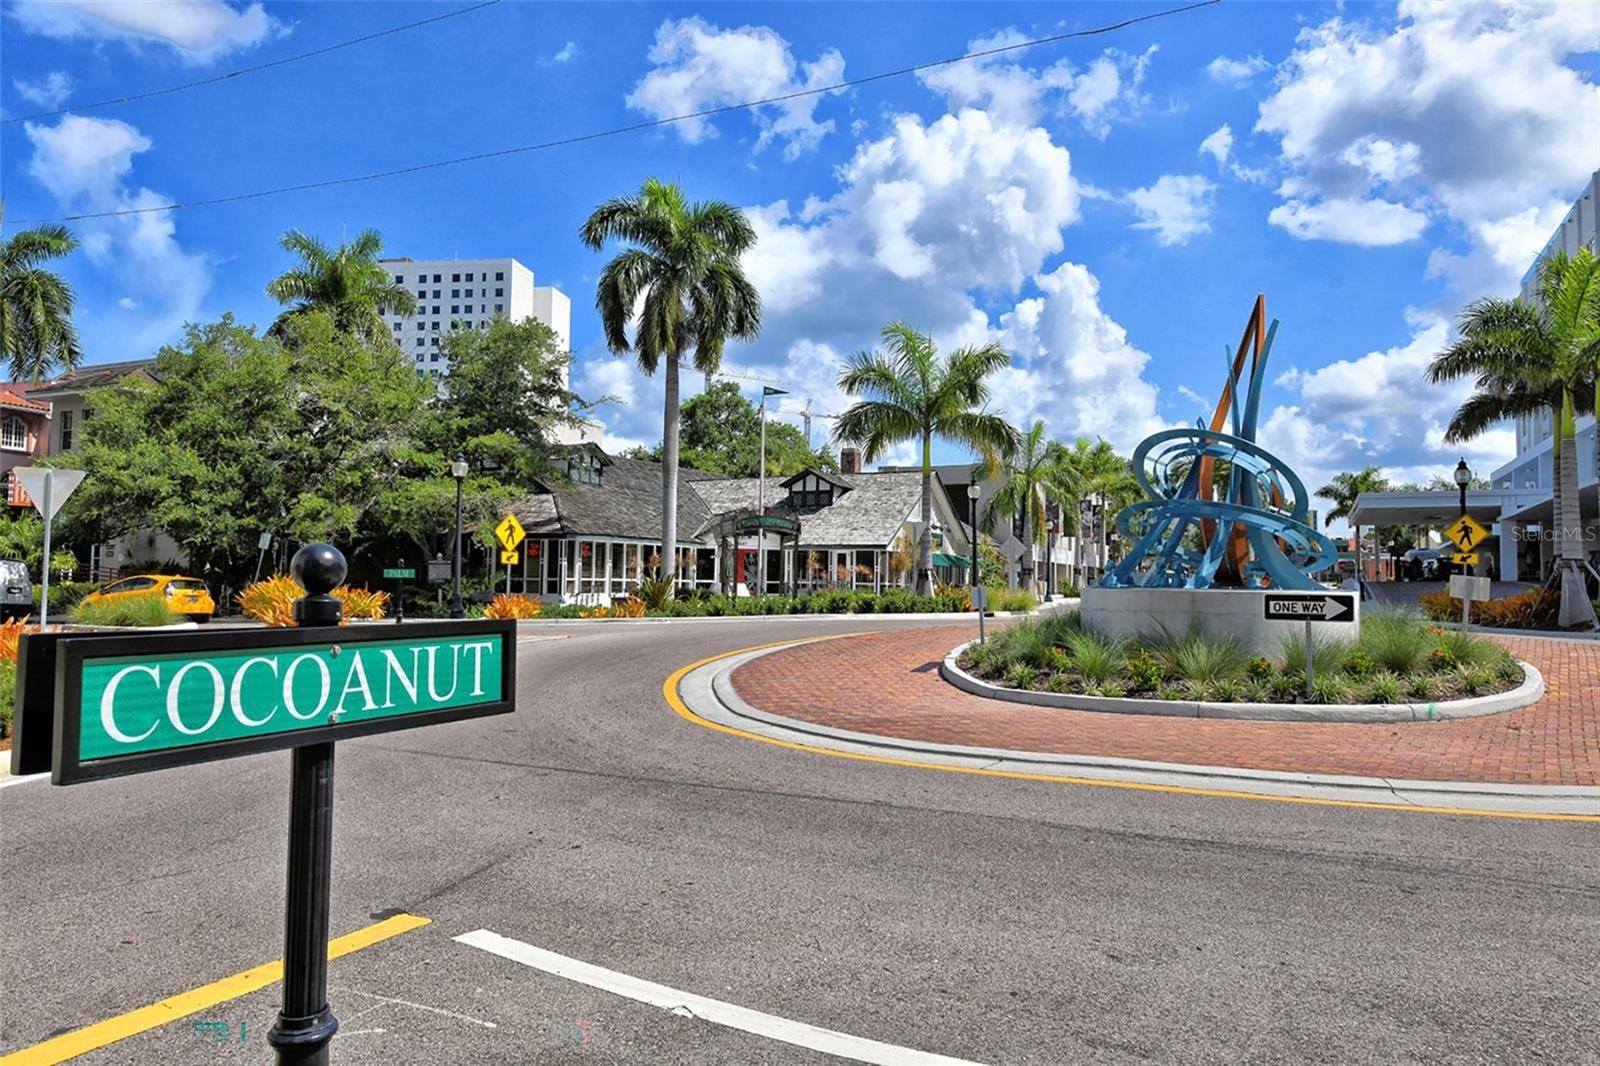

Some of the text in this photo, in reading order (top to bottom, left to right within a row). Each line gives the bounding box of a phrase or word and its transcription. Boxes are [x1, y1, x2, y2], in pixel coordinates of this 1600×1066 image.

[1273, 602, 1326, 613] ONE WAY
[101, 642, 493, 743] COCOANUT
